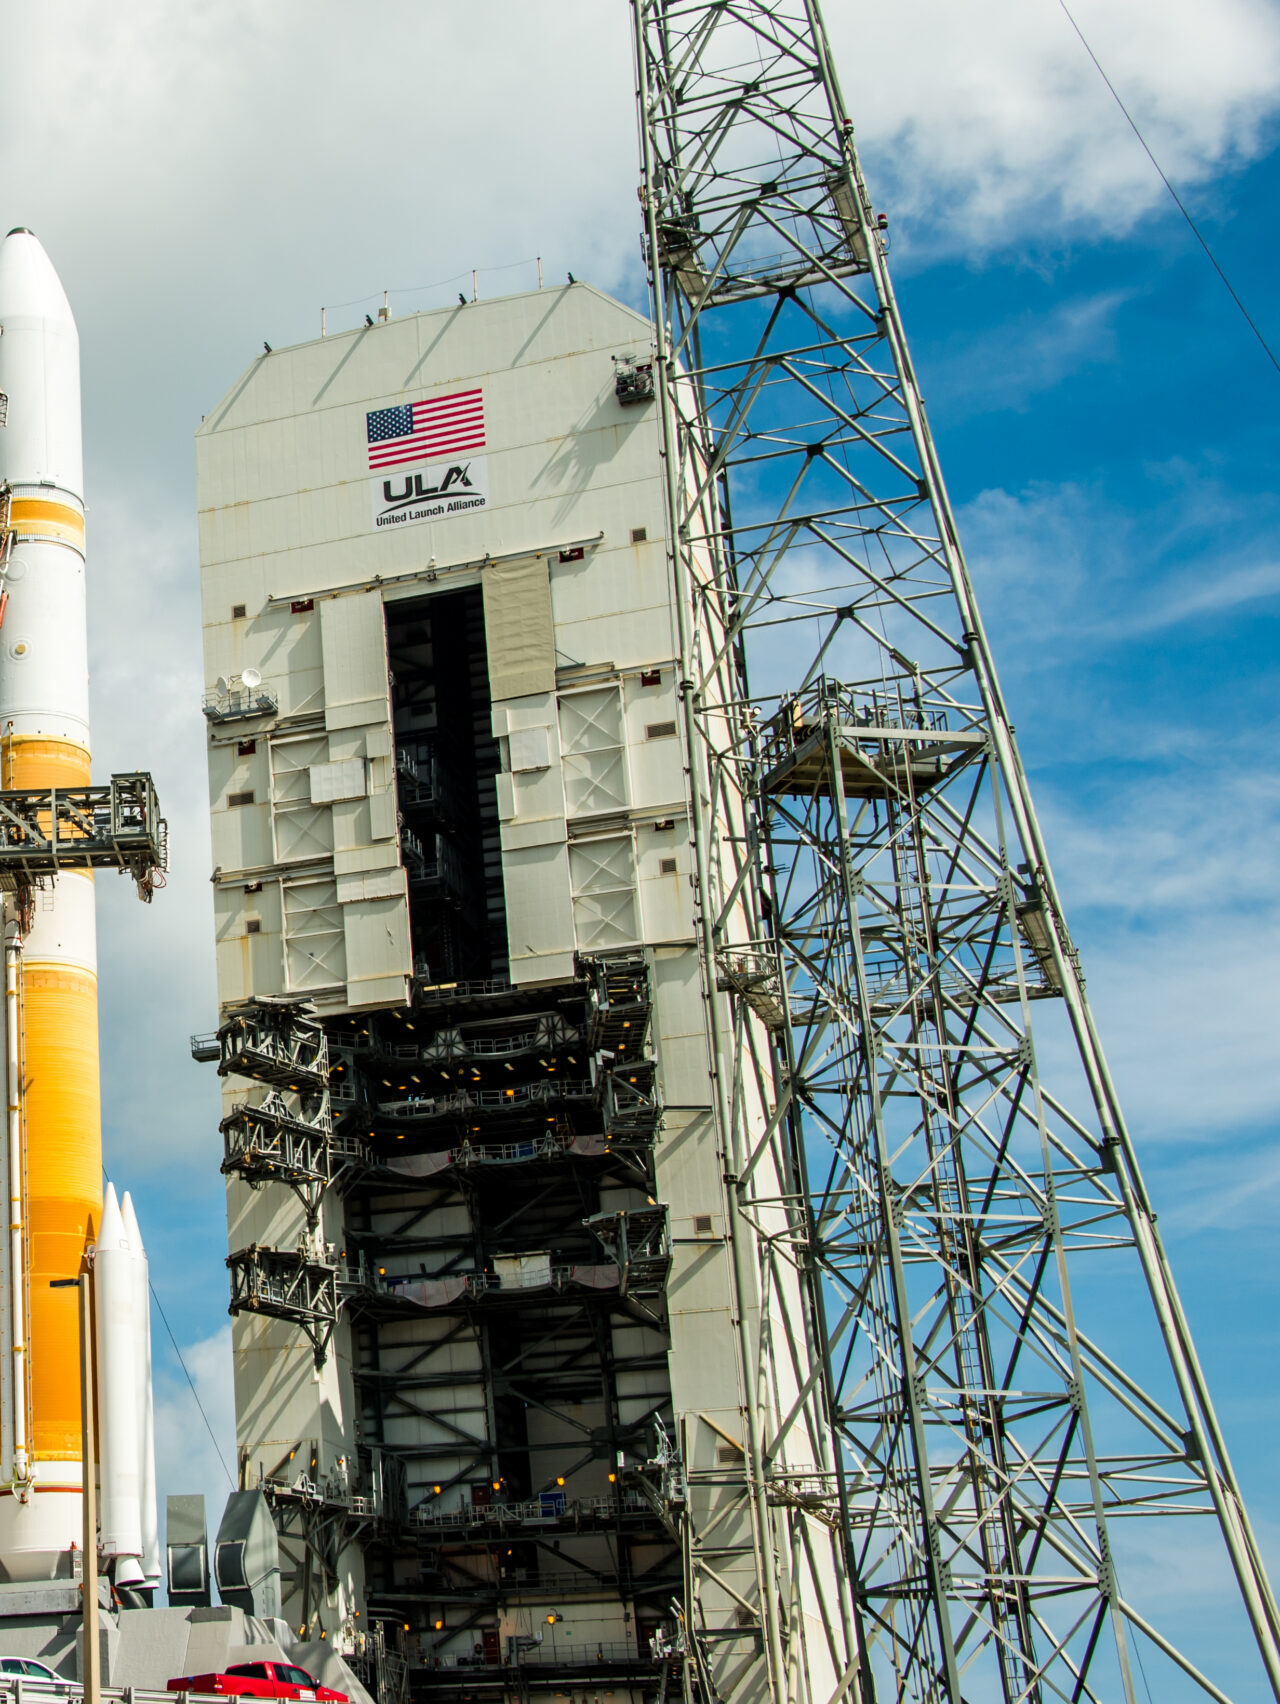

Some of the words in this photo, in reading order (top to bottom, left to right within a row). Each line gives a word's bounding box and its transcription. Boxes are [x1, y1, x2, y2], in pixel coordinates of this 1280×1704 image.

[383, 462, 472, 502] ULA
[376, 512, 406, 526] United
[409, 505, 444, 520] Launch
[447, 498, 486, 512] Alliance
